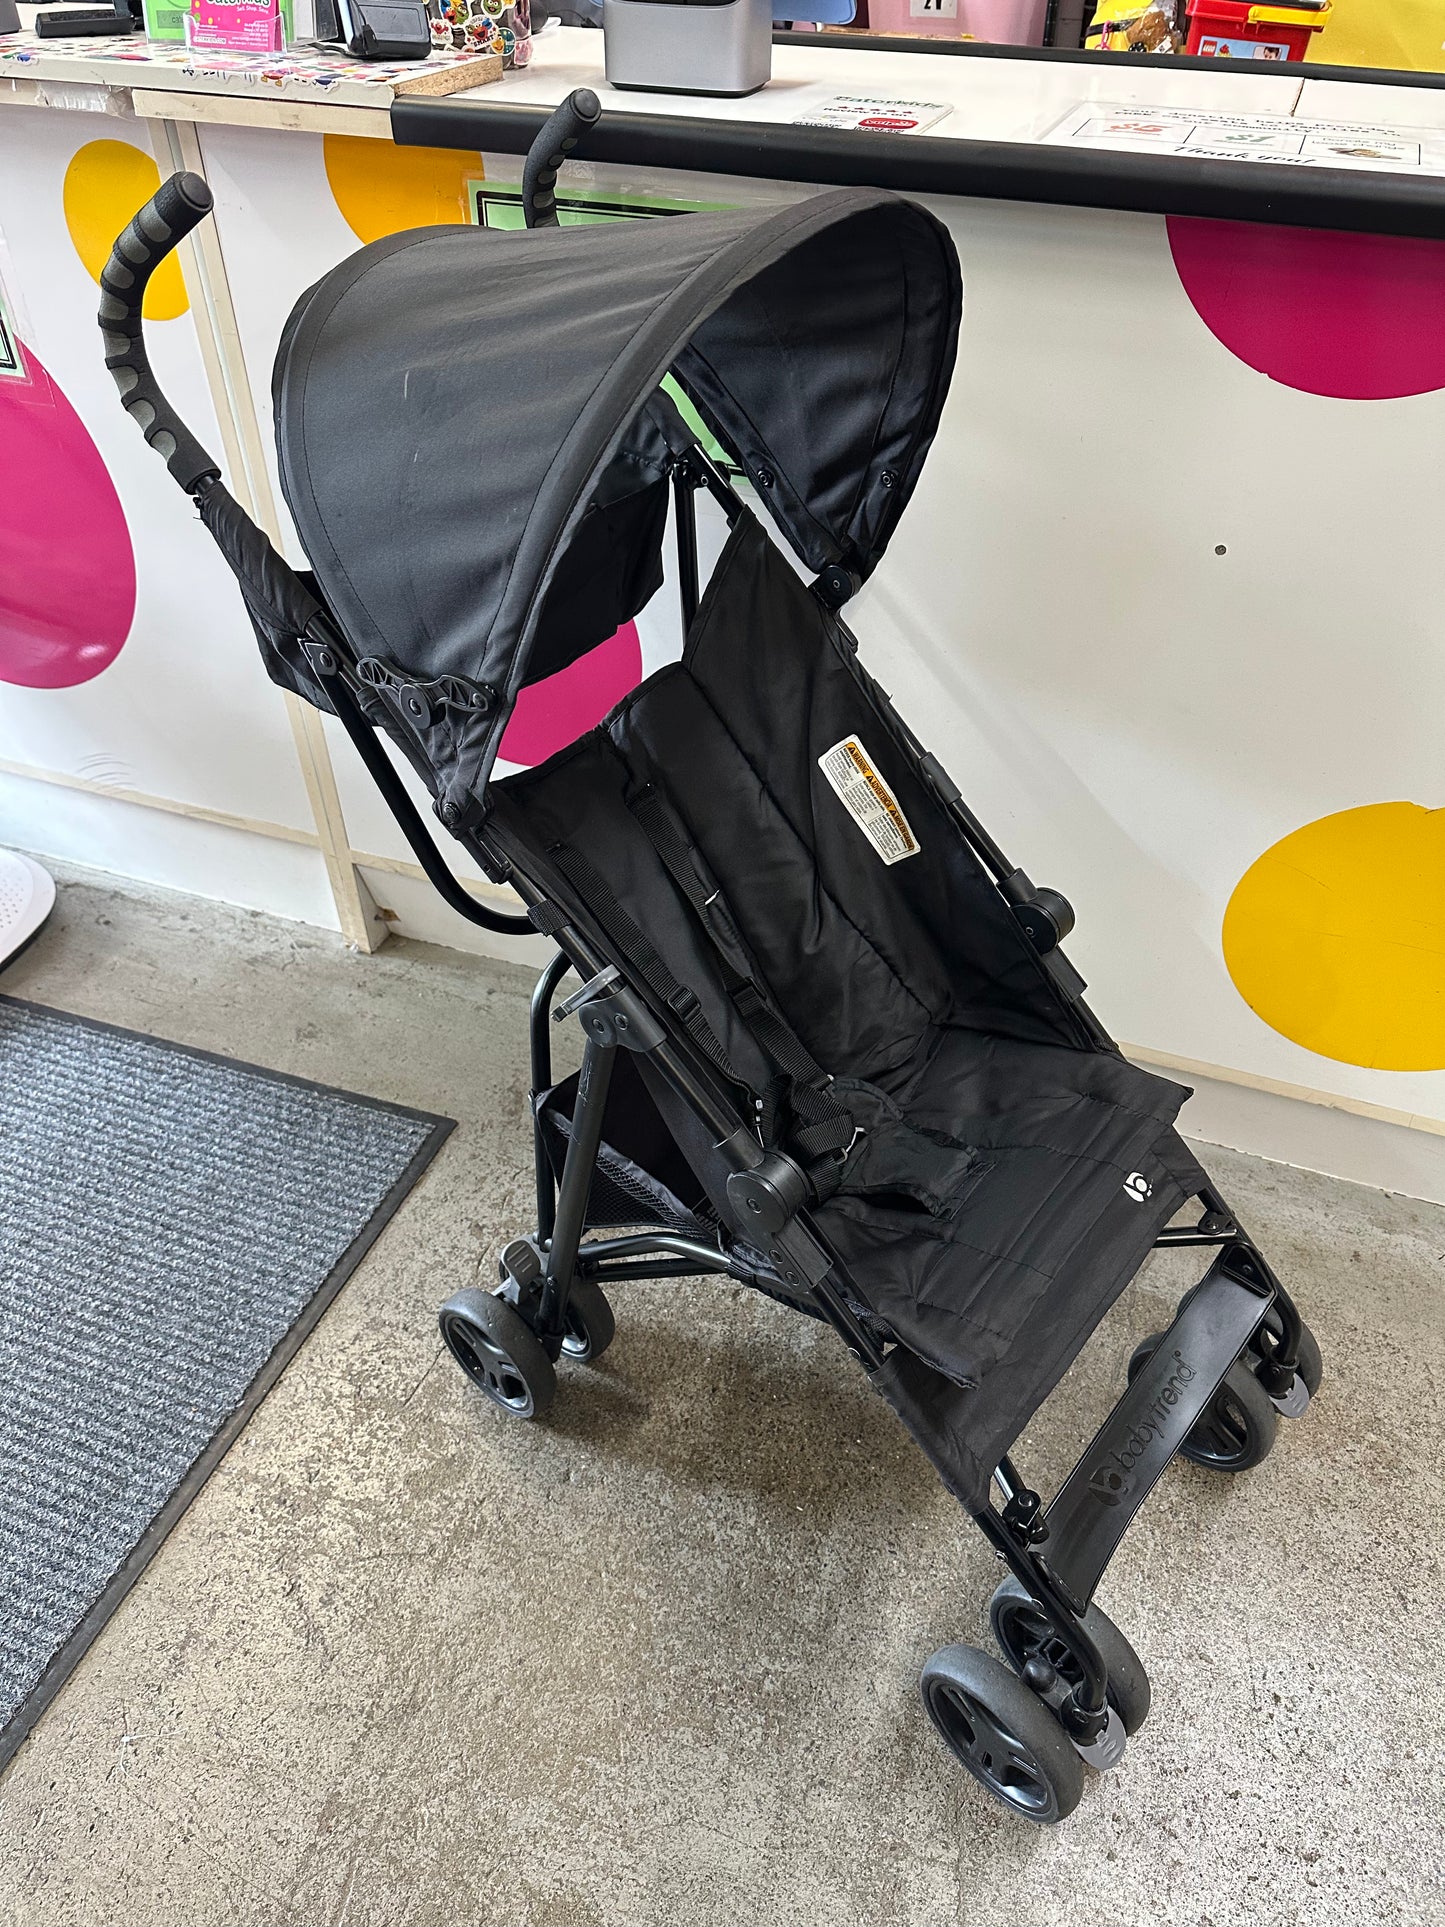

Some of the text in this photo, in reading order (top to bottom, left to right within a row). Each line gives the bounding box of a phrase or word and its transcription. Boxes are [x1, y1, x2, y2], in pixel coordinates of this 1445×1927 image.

[473, 34, 495, 47] SMART
[1202, 43, 1217, 53] LEGO
[1174, 146, 1251, 159] Thank
[853, 752, 869, 774] WARNING
